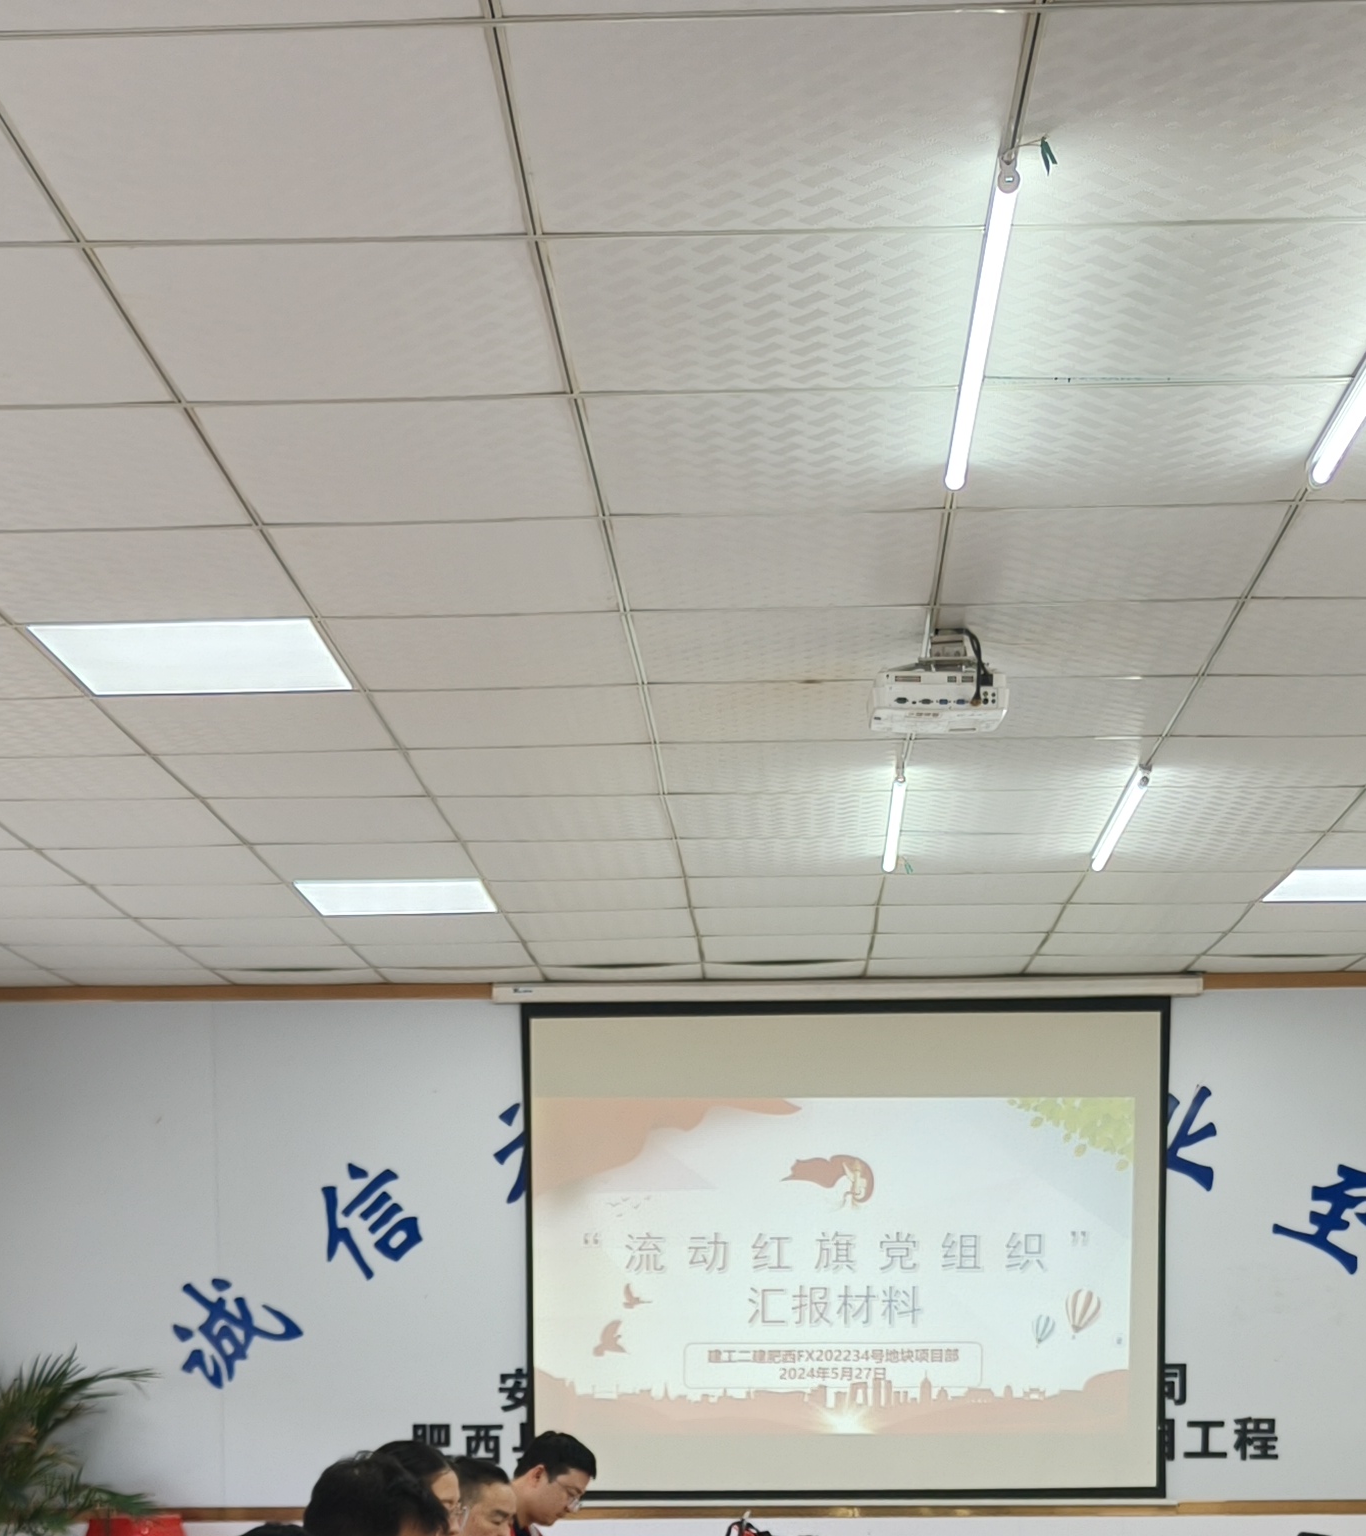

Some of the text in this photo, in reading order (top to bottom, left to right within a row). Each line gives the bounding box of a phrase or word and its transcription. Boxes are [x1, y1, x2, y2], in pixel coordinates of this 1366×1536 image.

[747, 1284, 923, 1328] 汇报材料
[778, 1366, 888, 1381] 2024年5月27日
